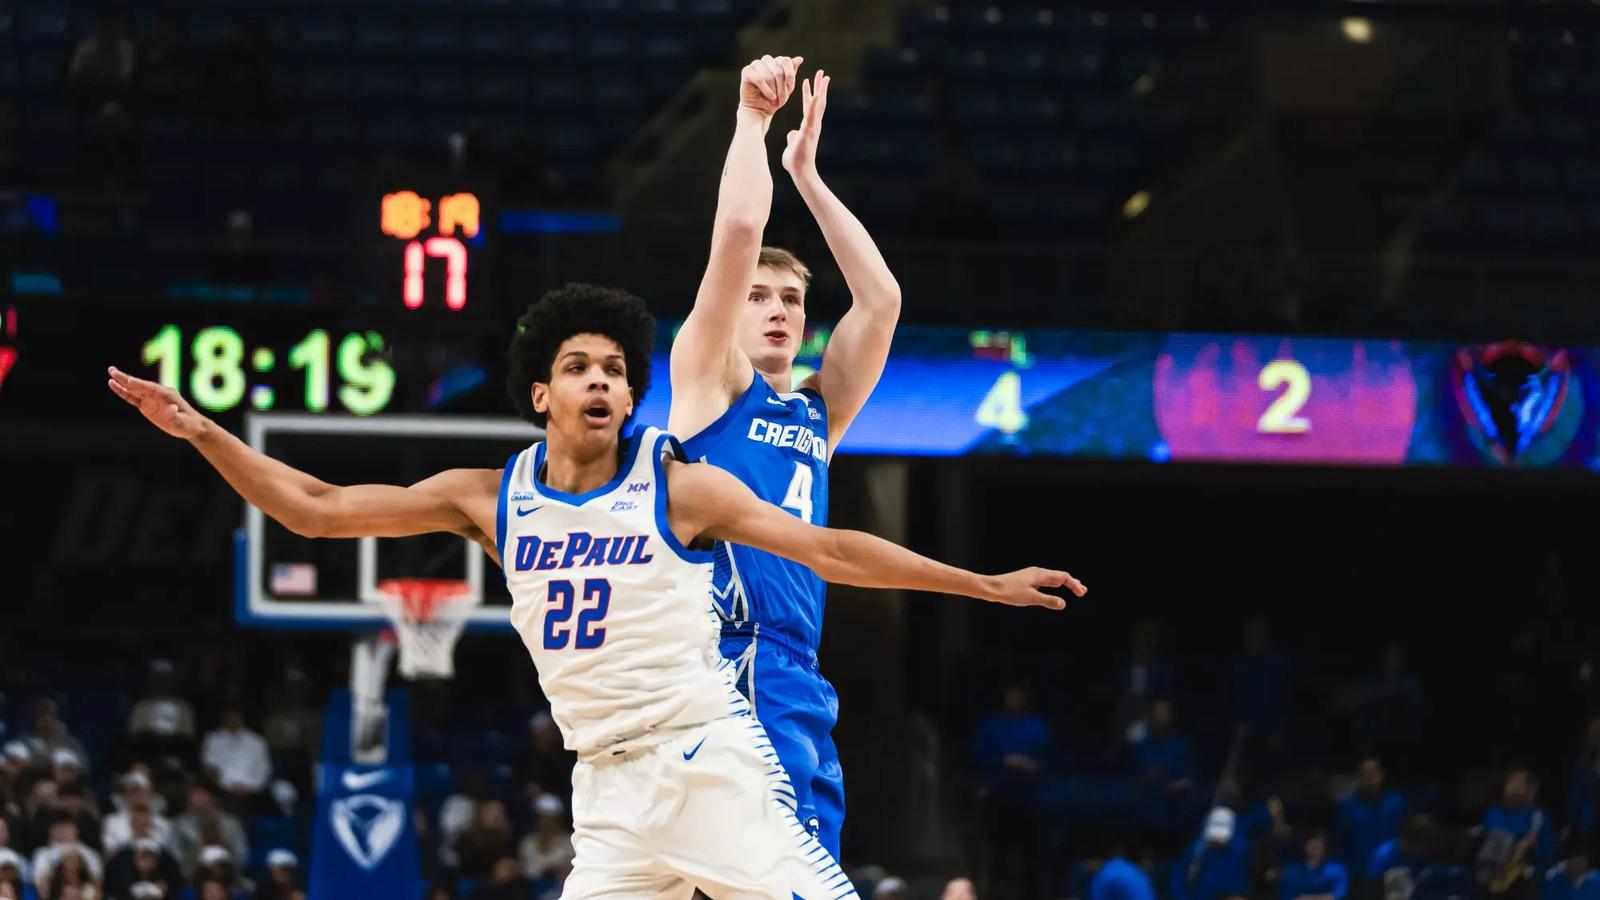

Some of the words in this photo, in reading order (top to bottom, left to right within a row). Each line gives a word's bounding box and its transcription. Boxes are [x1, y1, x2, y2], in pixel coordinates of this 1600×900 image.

[403, 238, 467, 311] 17
[141, 324, 396, 416] 18:19
[974, 371, 1030, 431] 4
[1257, 360, 1311, 433] 2
[780, 461, 813, 524] 4
[543, 578, 612, 650] 22
